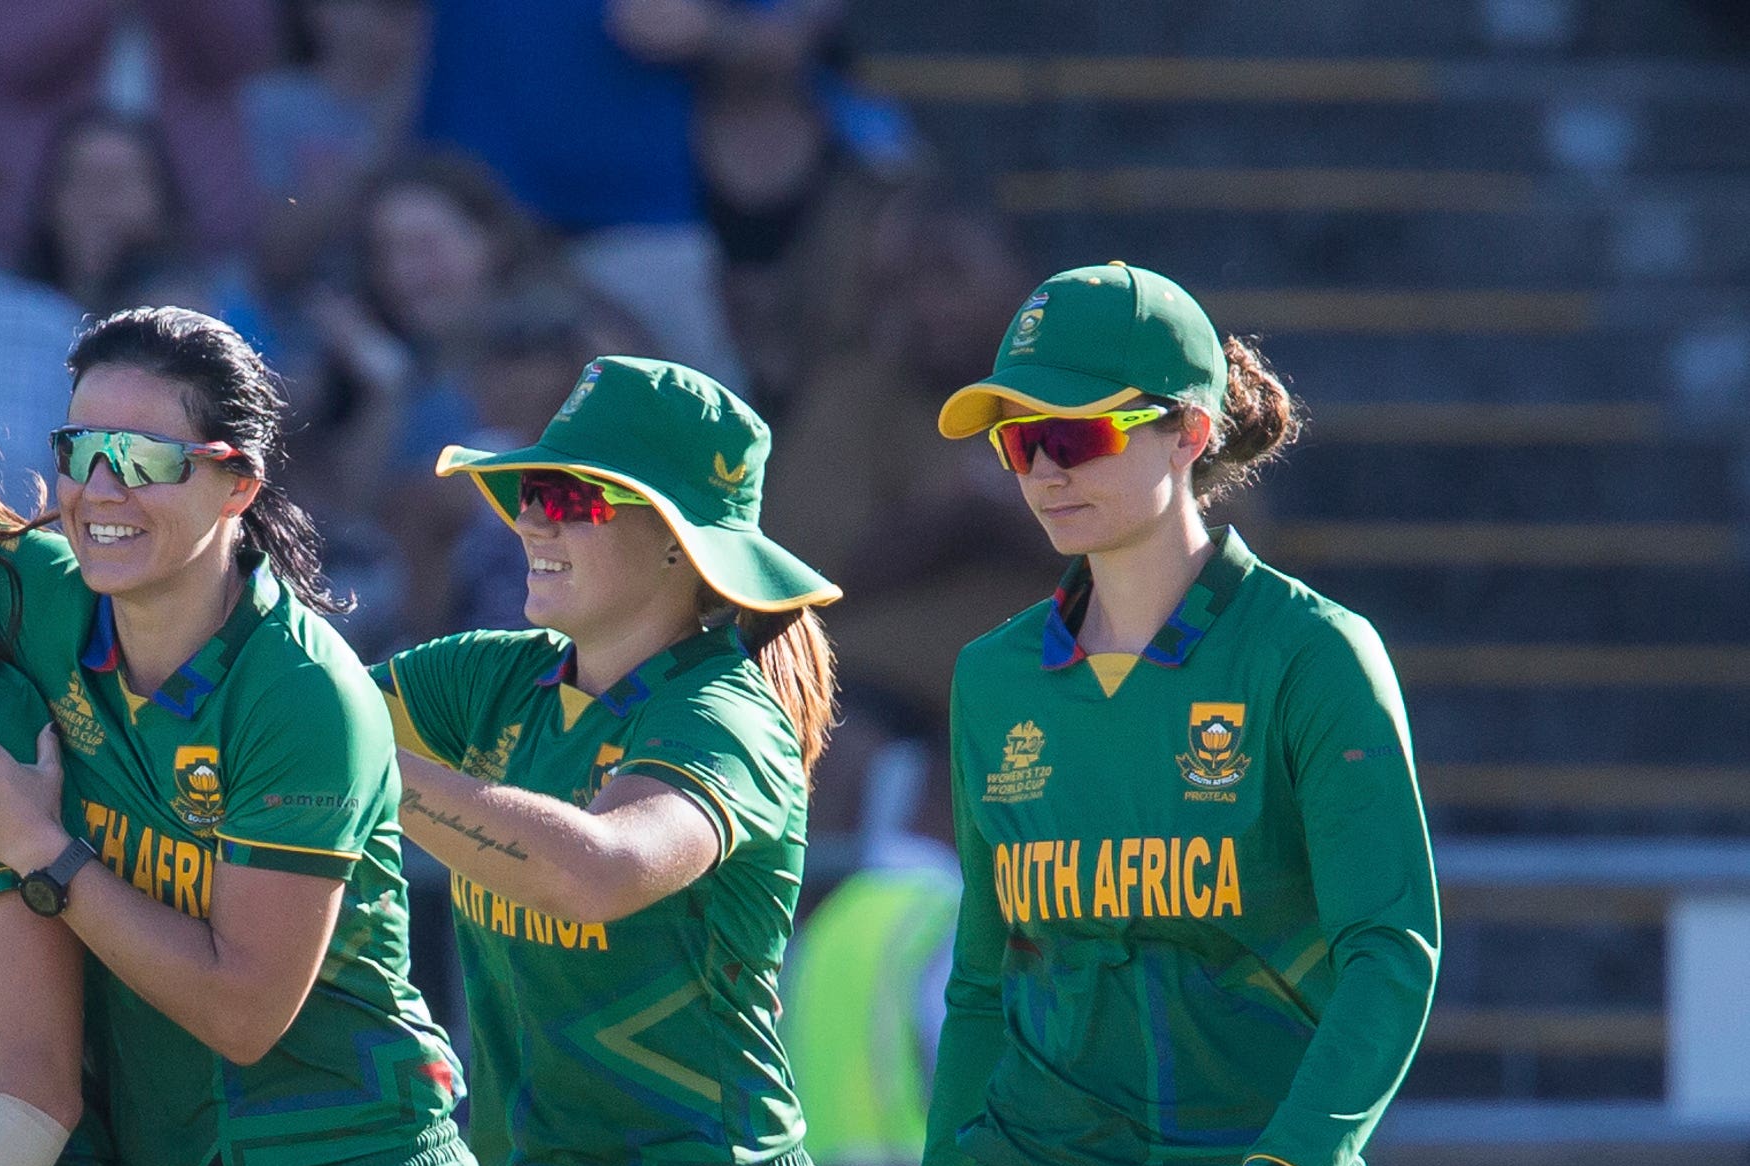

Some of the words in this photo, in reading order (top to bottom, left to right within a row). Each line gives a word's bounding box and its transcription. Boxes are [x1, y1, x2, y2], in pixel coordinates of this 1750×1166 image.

[1184, 791, 1237, 803] PROTEAS
[132, 826, 214, 919] AFRI
[1093, 836, 1242, 917] AFRICA
